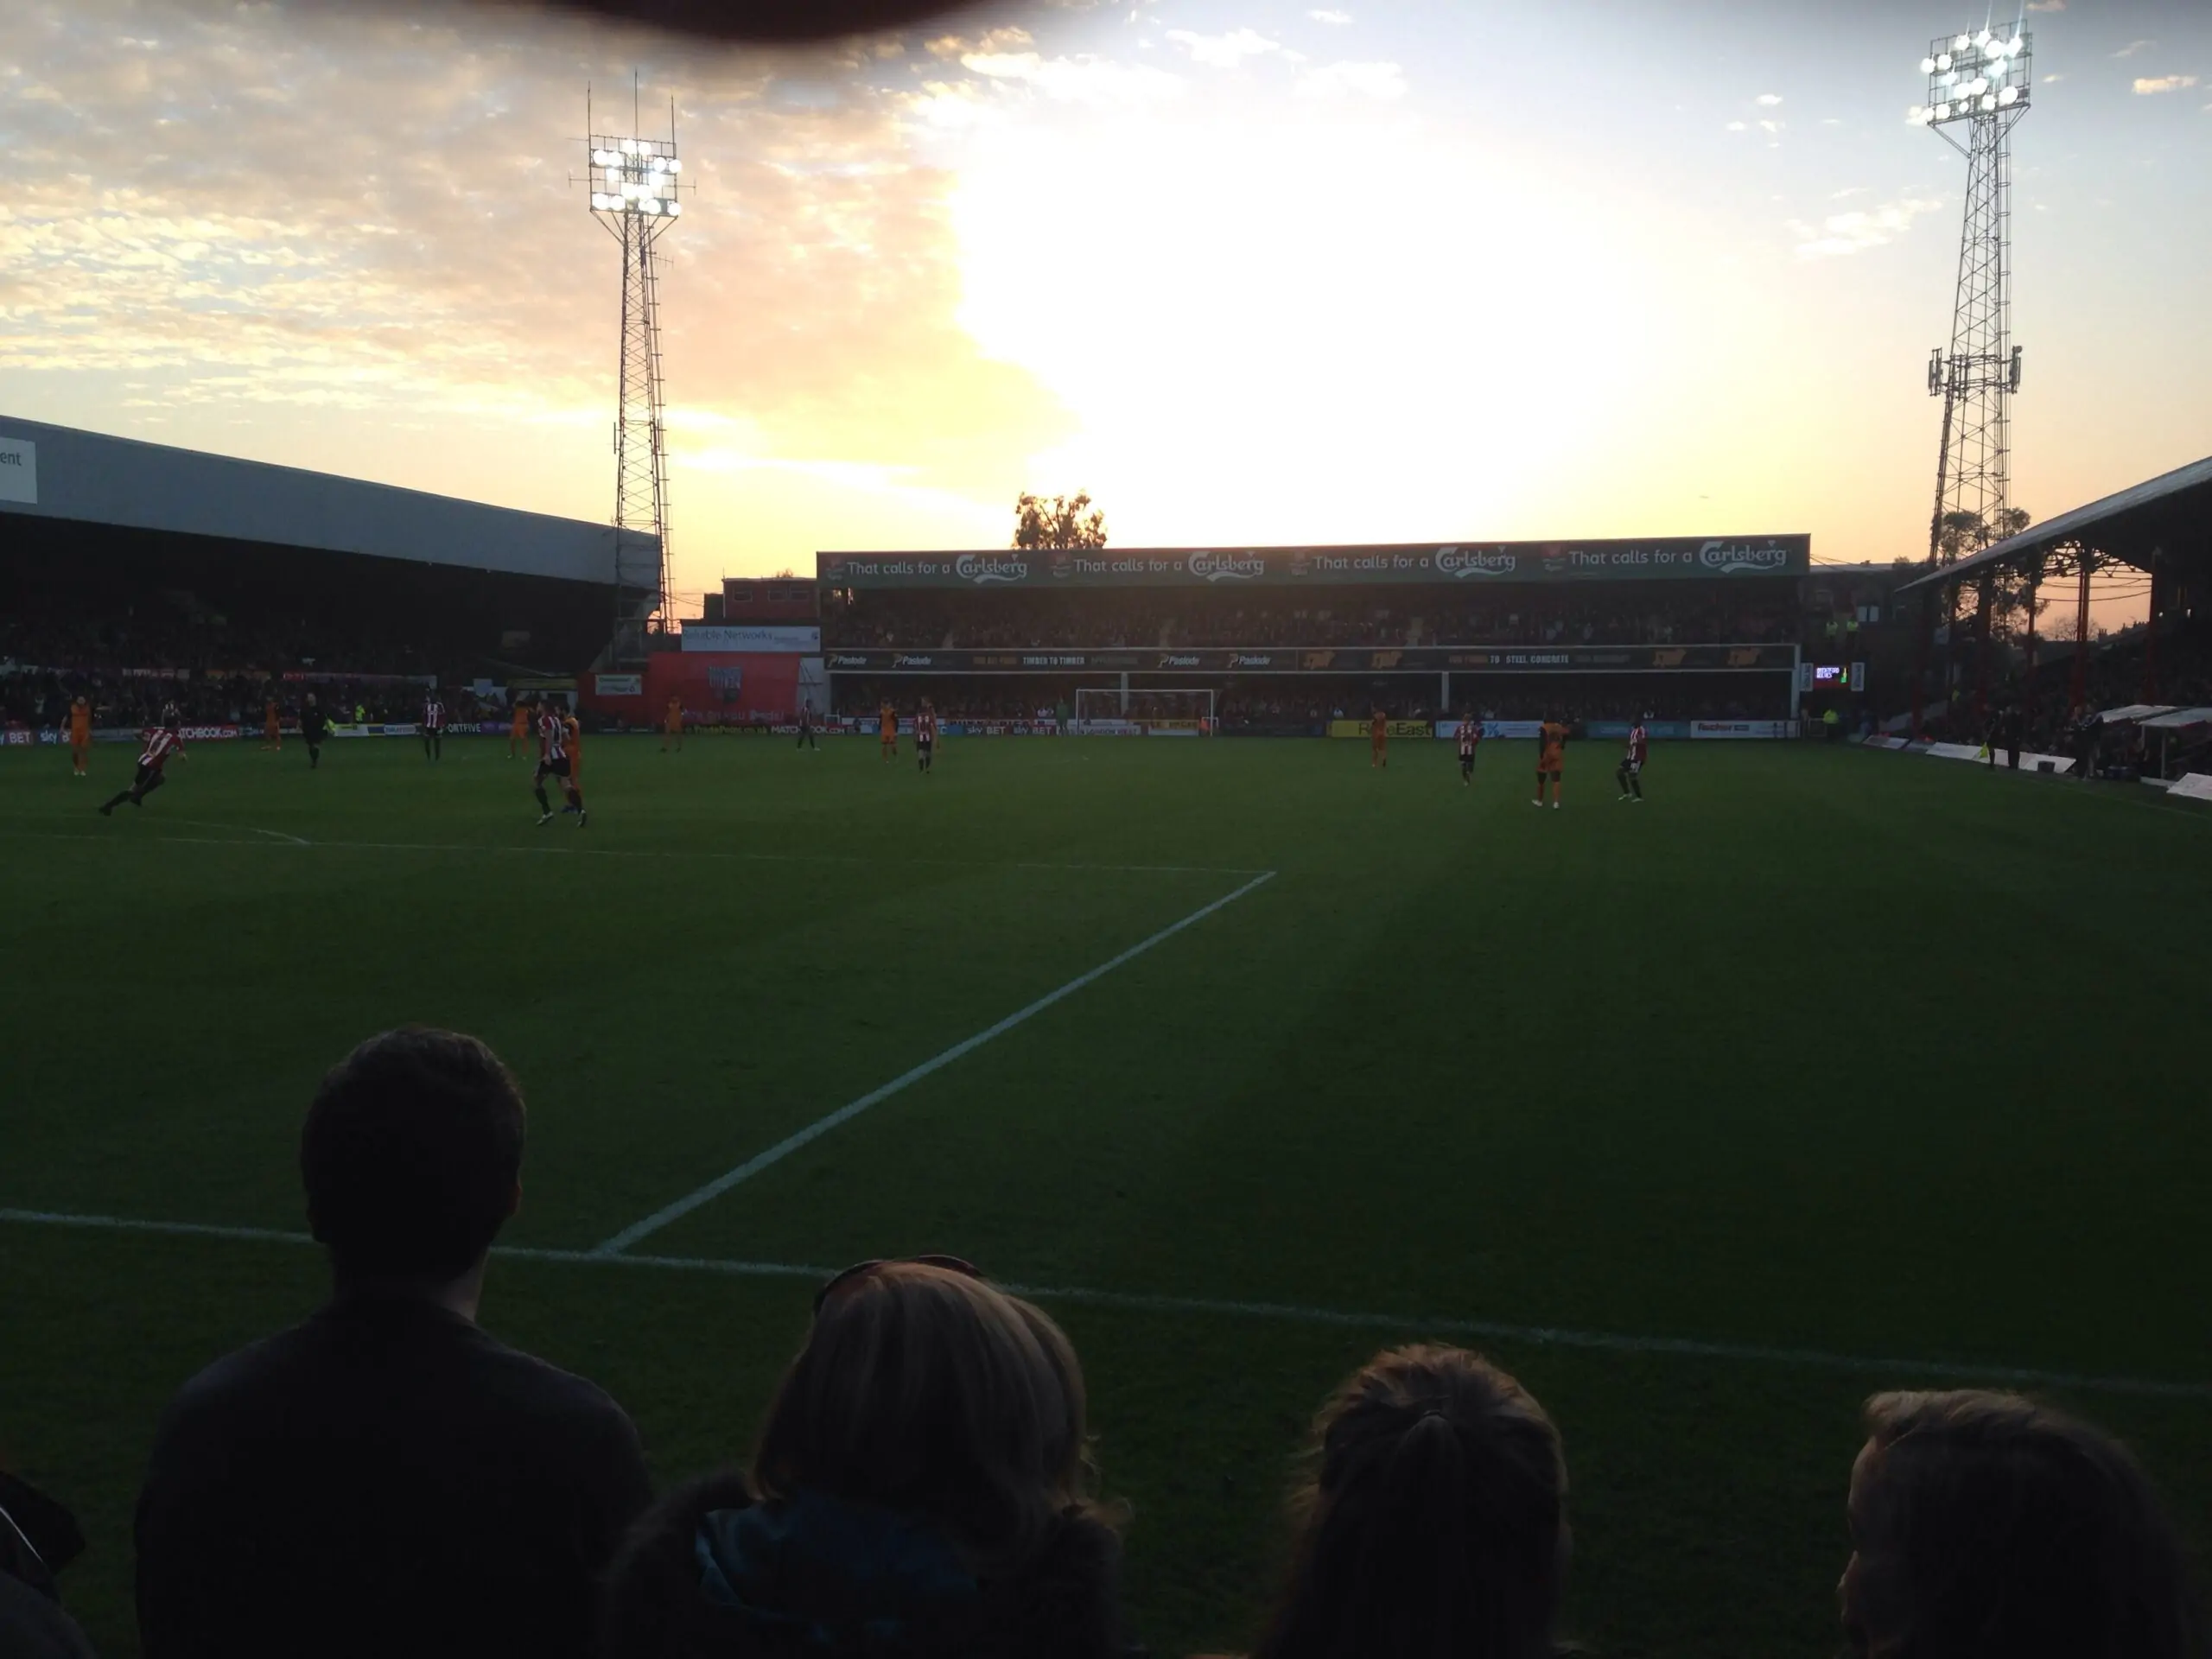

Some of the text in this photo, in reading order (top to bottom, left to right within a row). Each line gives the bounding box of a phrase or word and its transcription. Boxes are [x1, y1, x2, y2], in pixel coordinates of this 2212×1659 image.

[848, 554, 1027, 582] That calls for a Carlsberg
[1073, 551, 1264, 581] That calls for a Carlsberg
[1314, 546, 1516, 577] That calls for a Carlsberg
[1568, 541, 1786, 572] That calls for a Carlsberg
[9, 732, 30, 743] BET
[40, 729, 58, 746] sky
[177, 727, 238, 740] ATCHBOOK.COM
[967, 726, 983, 738] sky
[986, 726, 1006, 735] BET
[1032, 726, 1052, 735] BET
